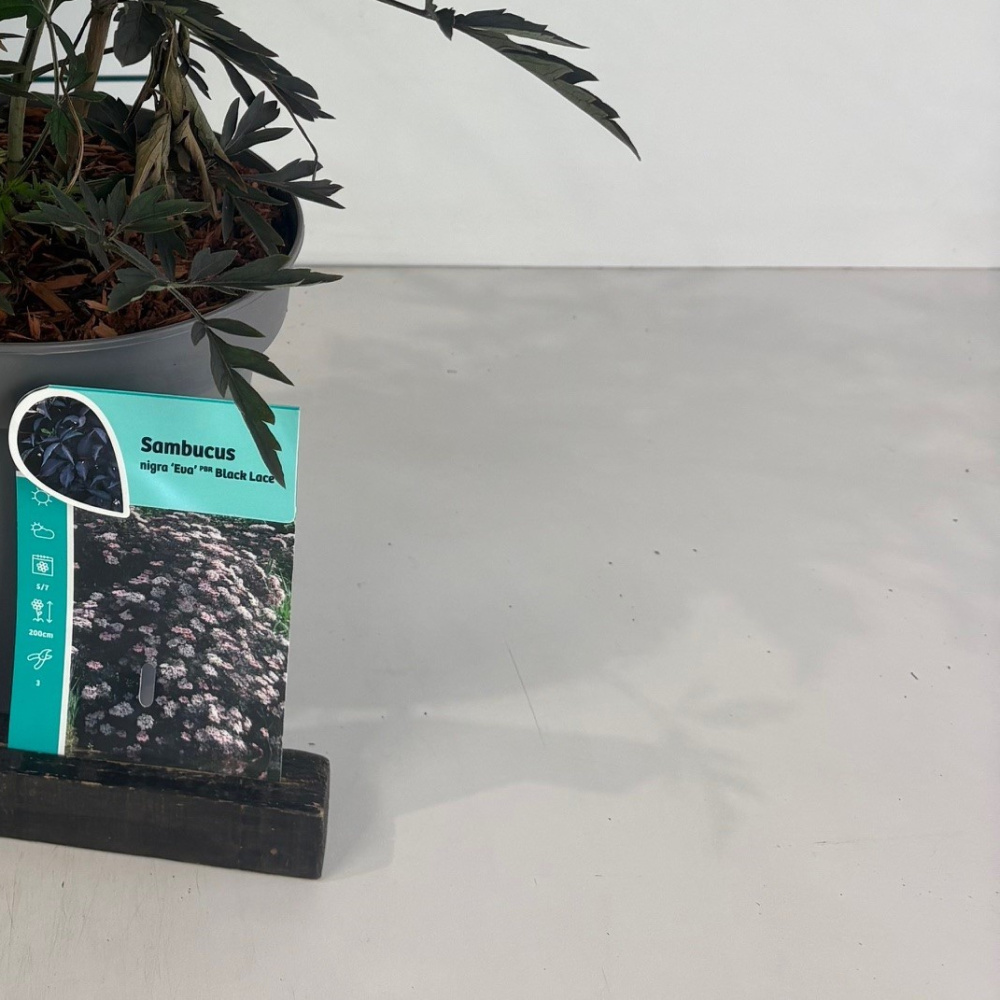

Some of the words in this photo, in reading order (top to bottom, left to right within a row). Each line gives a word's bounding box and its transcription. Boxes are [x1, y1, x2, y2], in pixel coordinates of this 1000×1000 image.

[140, 436, 236, 461] Sambucus
[139, 460, 168, 474] nigra
[199, 465, 213, 473] PBR
[215, 468, 247, 481] Black
[249, 471, 276, 484] Lace
[28, 628, 54, 639] 200cm
[35, 679, 41, 687] 3
